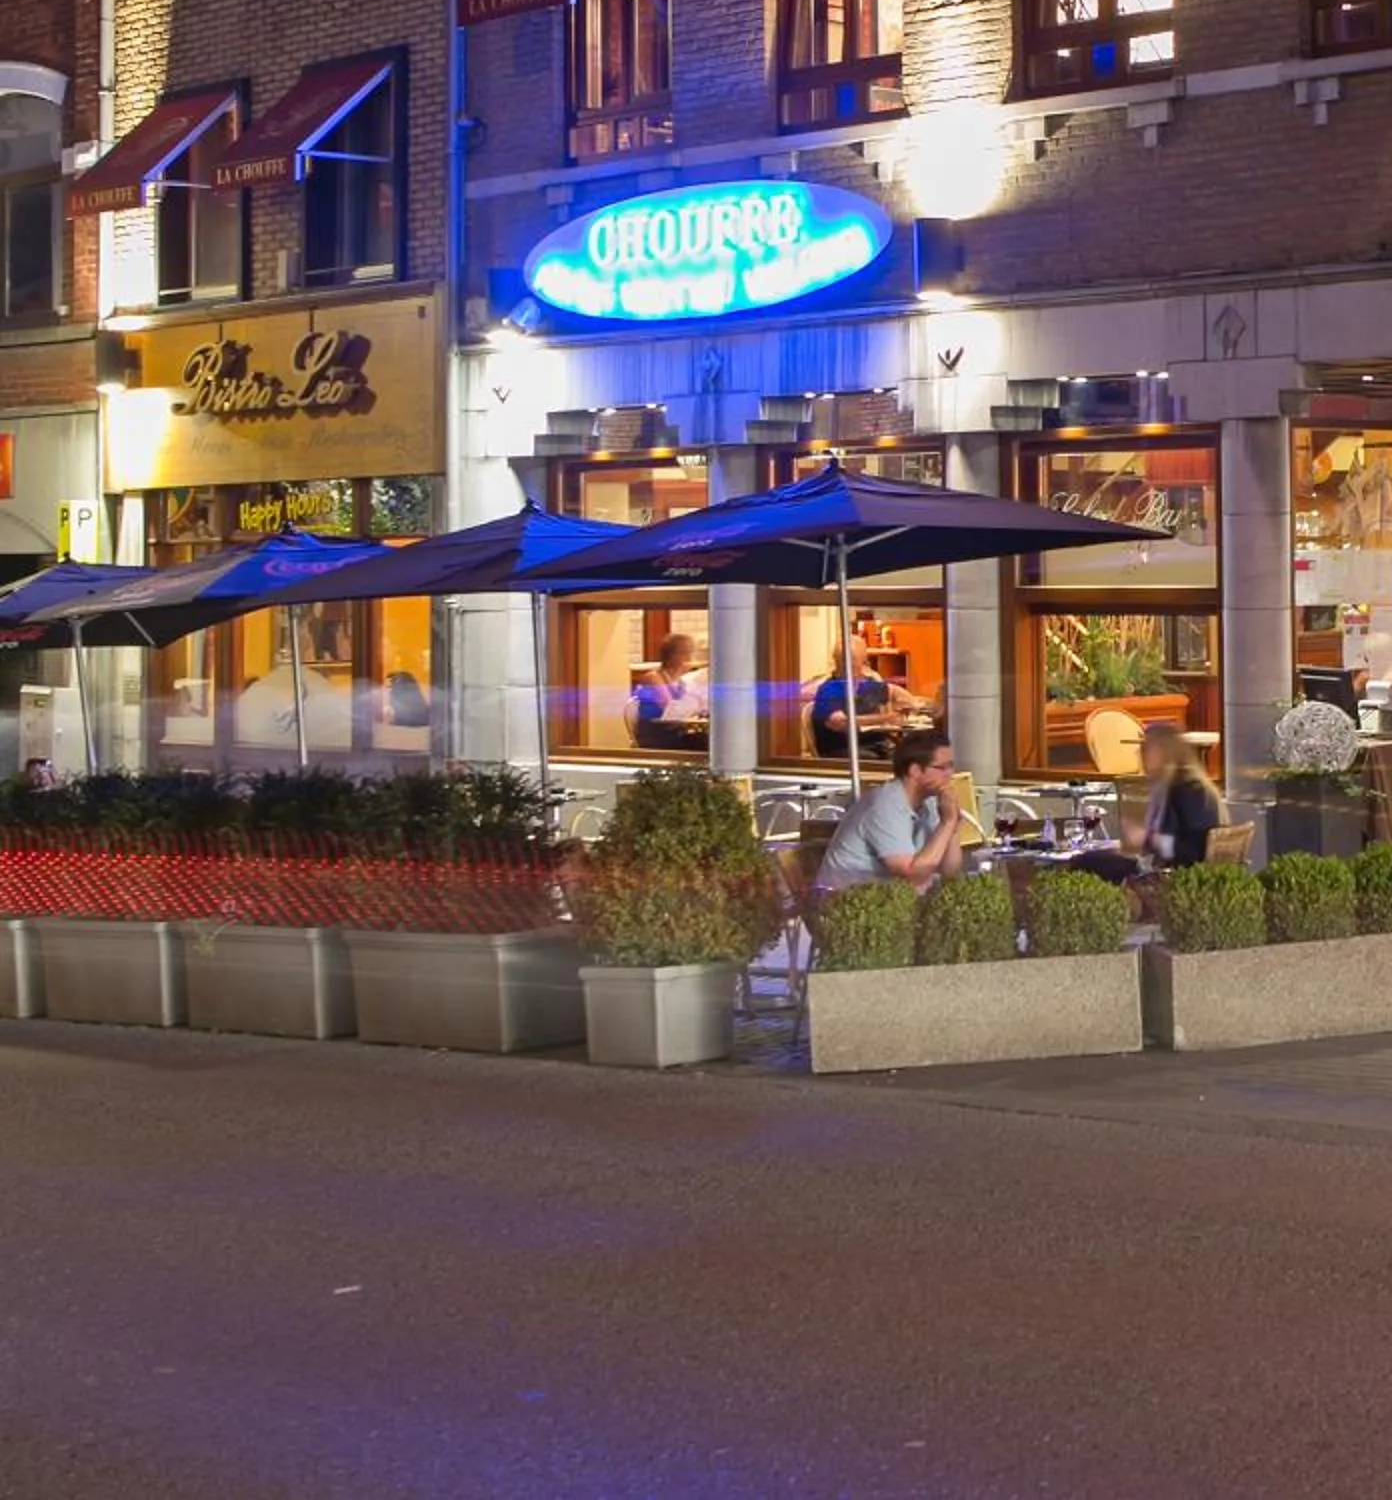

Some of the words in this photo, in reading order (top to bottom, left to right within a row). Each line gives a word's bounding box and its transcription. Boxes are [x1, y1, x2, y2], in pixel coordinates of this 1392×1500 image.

[217, 168, 231, 184] LA
[235, 158, 287, 182] CHOUFFE
[71, 194, 85, 213] LA
[172, 340, 272, 414] Bistro
[78, 508, 93, 528] P
[239, 500, 283, 532] Happy
